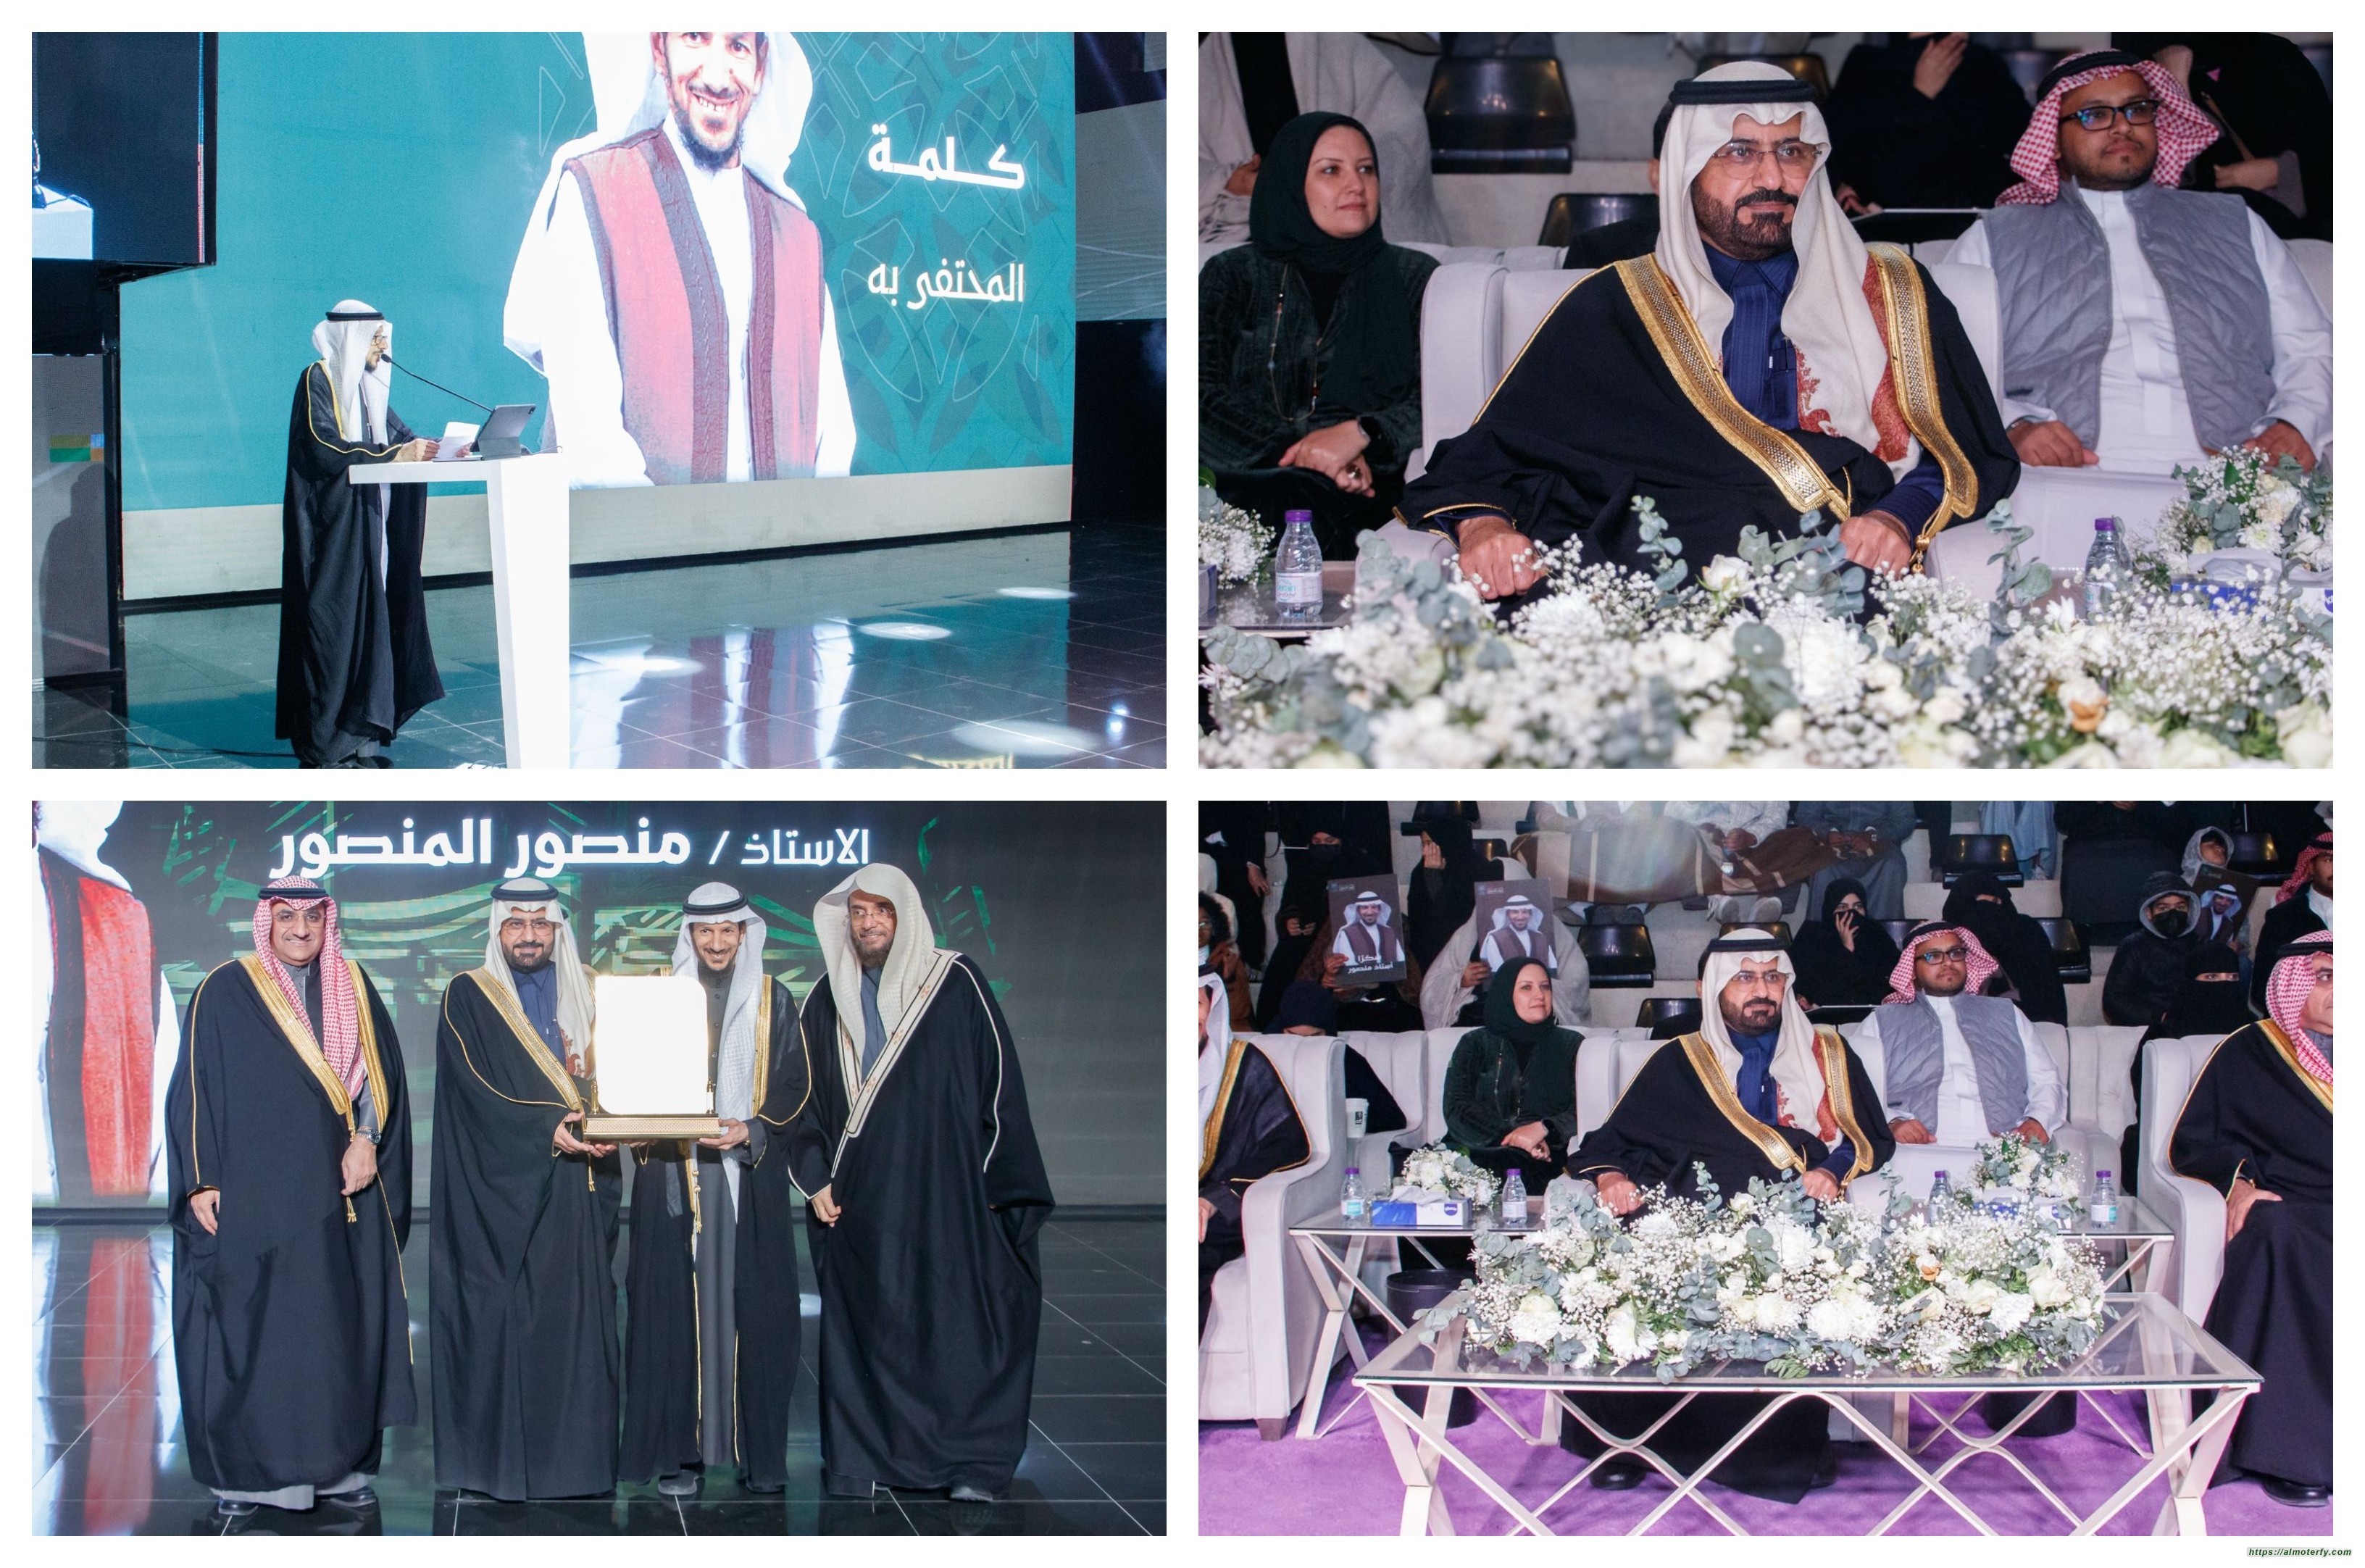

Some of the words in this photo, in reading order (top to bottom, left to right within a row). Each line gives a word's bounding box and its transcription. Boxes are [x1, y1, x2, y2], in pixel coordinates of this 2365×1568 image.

[868, 124, 1025, 189] كلمة
[868, 262, 898, 306] به
[269, 817, 491, 879] المنصور
[504, 817, 691, 879] منصور
[741, 828, 869, 866] الاستاذ
[1348, 965, 1372, 974] منصور
